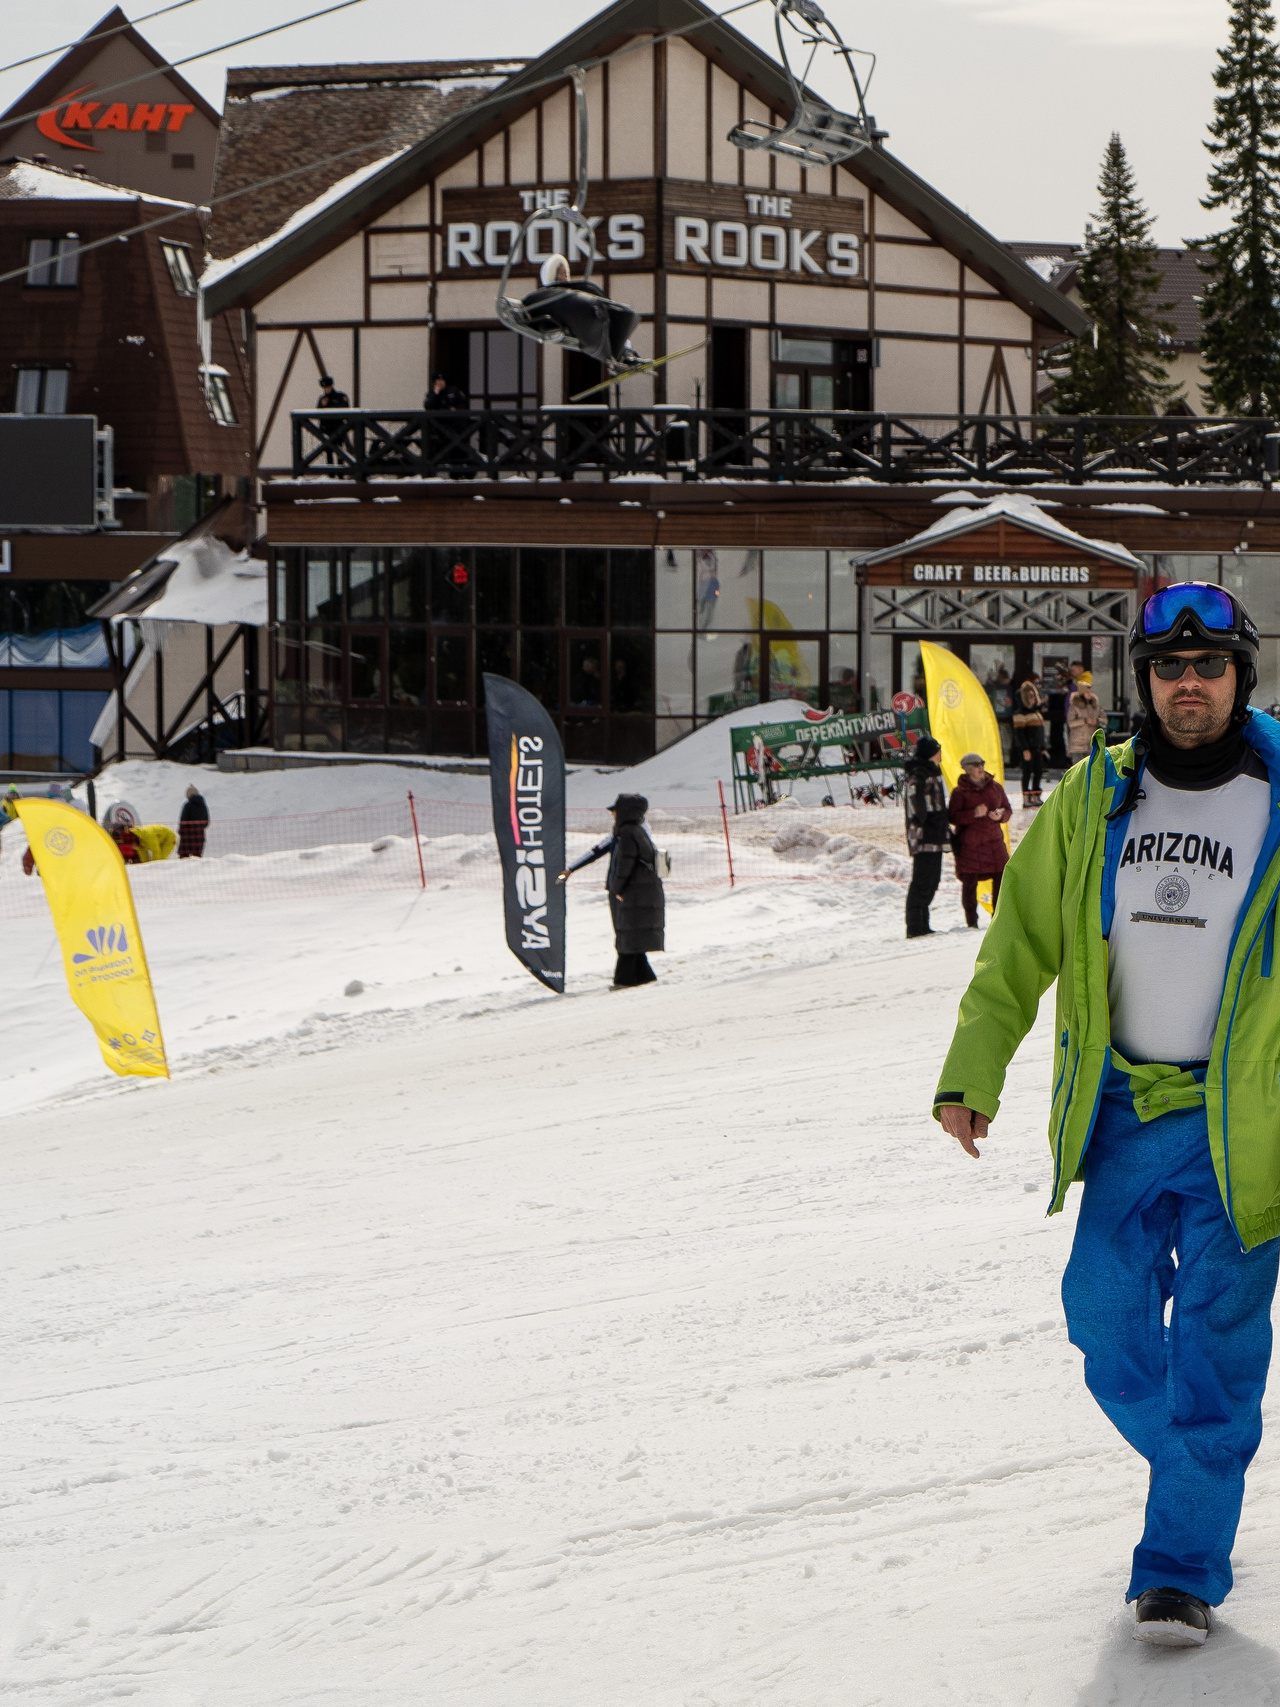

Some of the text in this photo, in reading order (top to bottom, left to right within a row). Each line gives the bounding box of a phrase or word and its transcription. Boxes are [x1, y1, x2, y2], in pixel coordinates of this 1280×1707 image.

[518, 188, 570, 212] THE
[743, 193, 793, 219] THE
[447, 214, 645, 268] ROOKS
[674, 215, 860, 277] ROOKS
[913, 564, 963, 581] CRAFT
[1119, 831, 1234, 880] ARIZONA
[1135, 865, 1216, 881] STATE
[1142, 914, 1195, 923] UNIVERSITY
